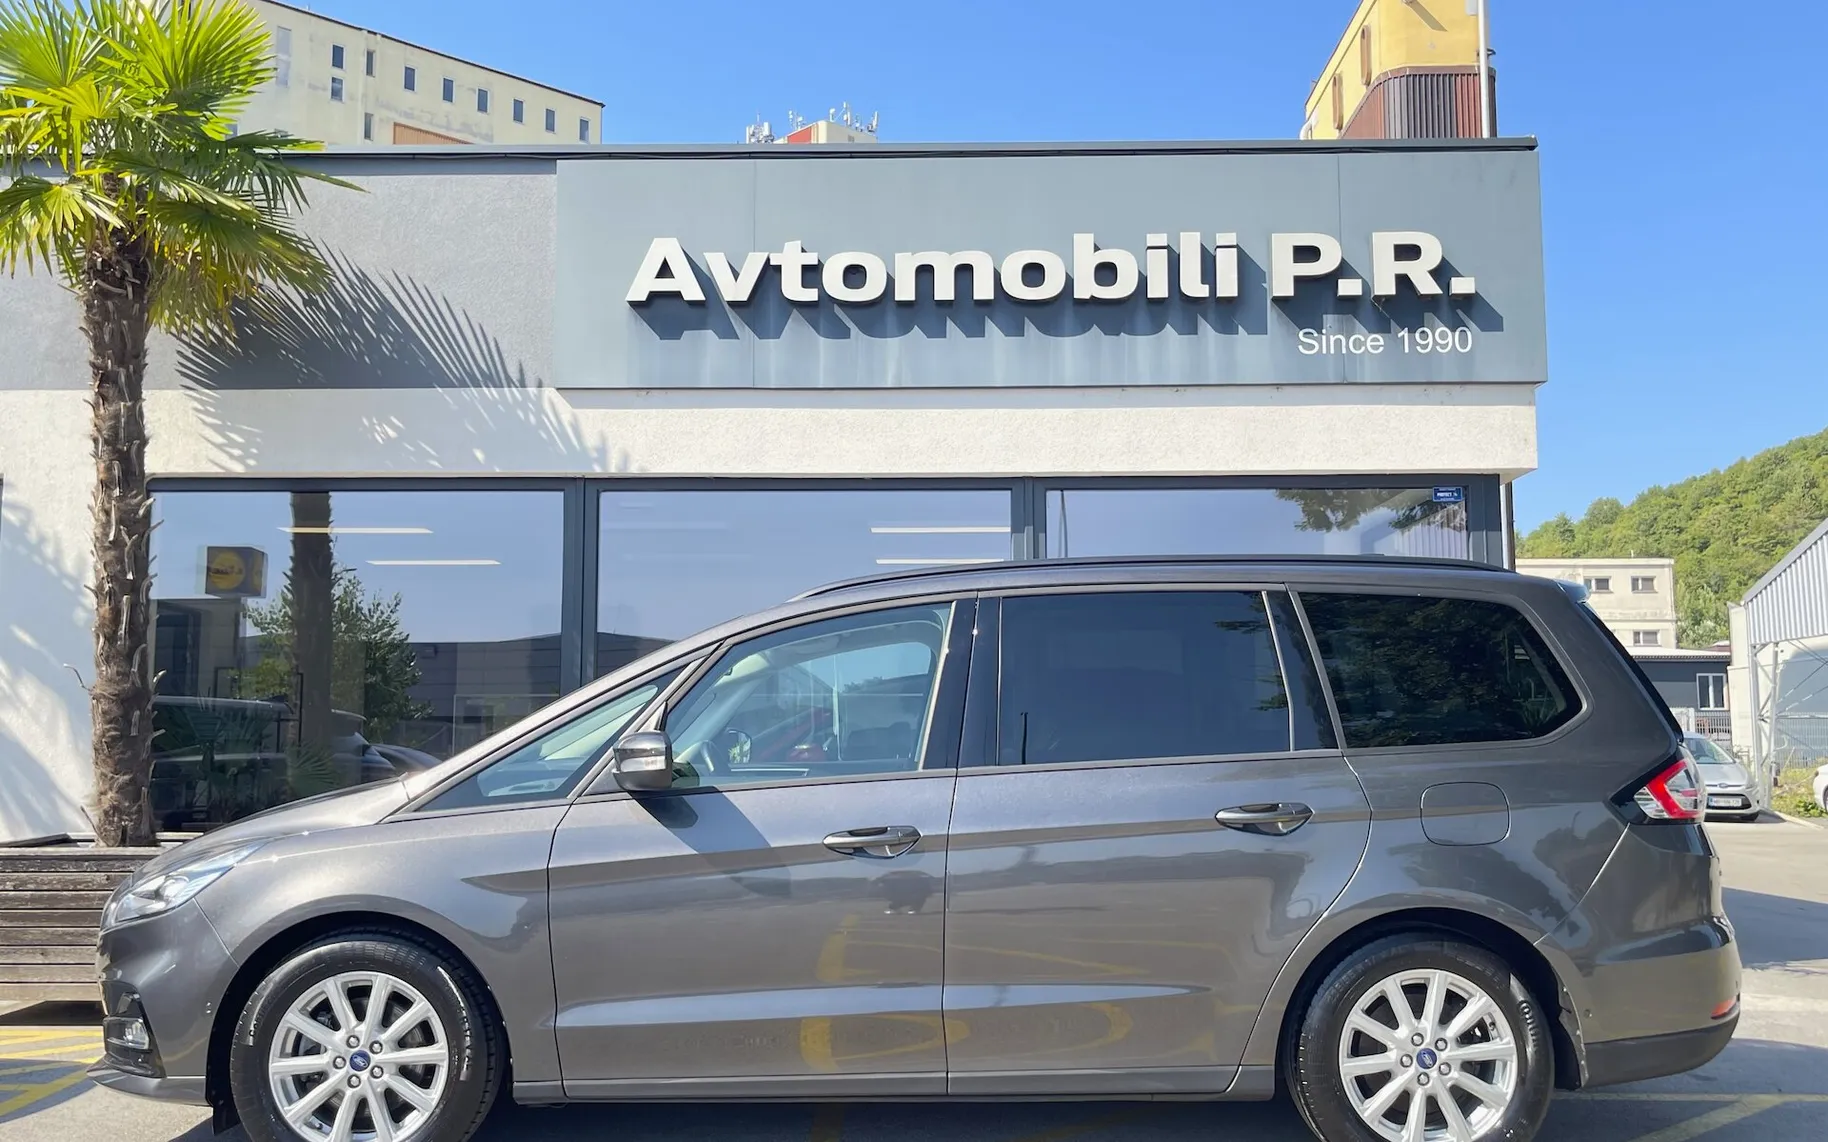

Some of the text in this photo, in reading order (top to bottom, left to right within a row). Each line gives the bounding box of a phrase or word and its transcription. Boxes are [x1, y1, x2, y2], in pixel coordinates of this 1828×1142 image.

[626, 231, 1476, 303] Avtomobili P.R.
[1297, 326, 1472, 355] Since 1990
